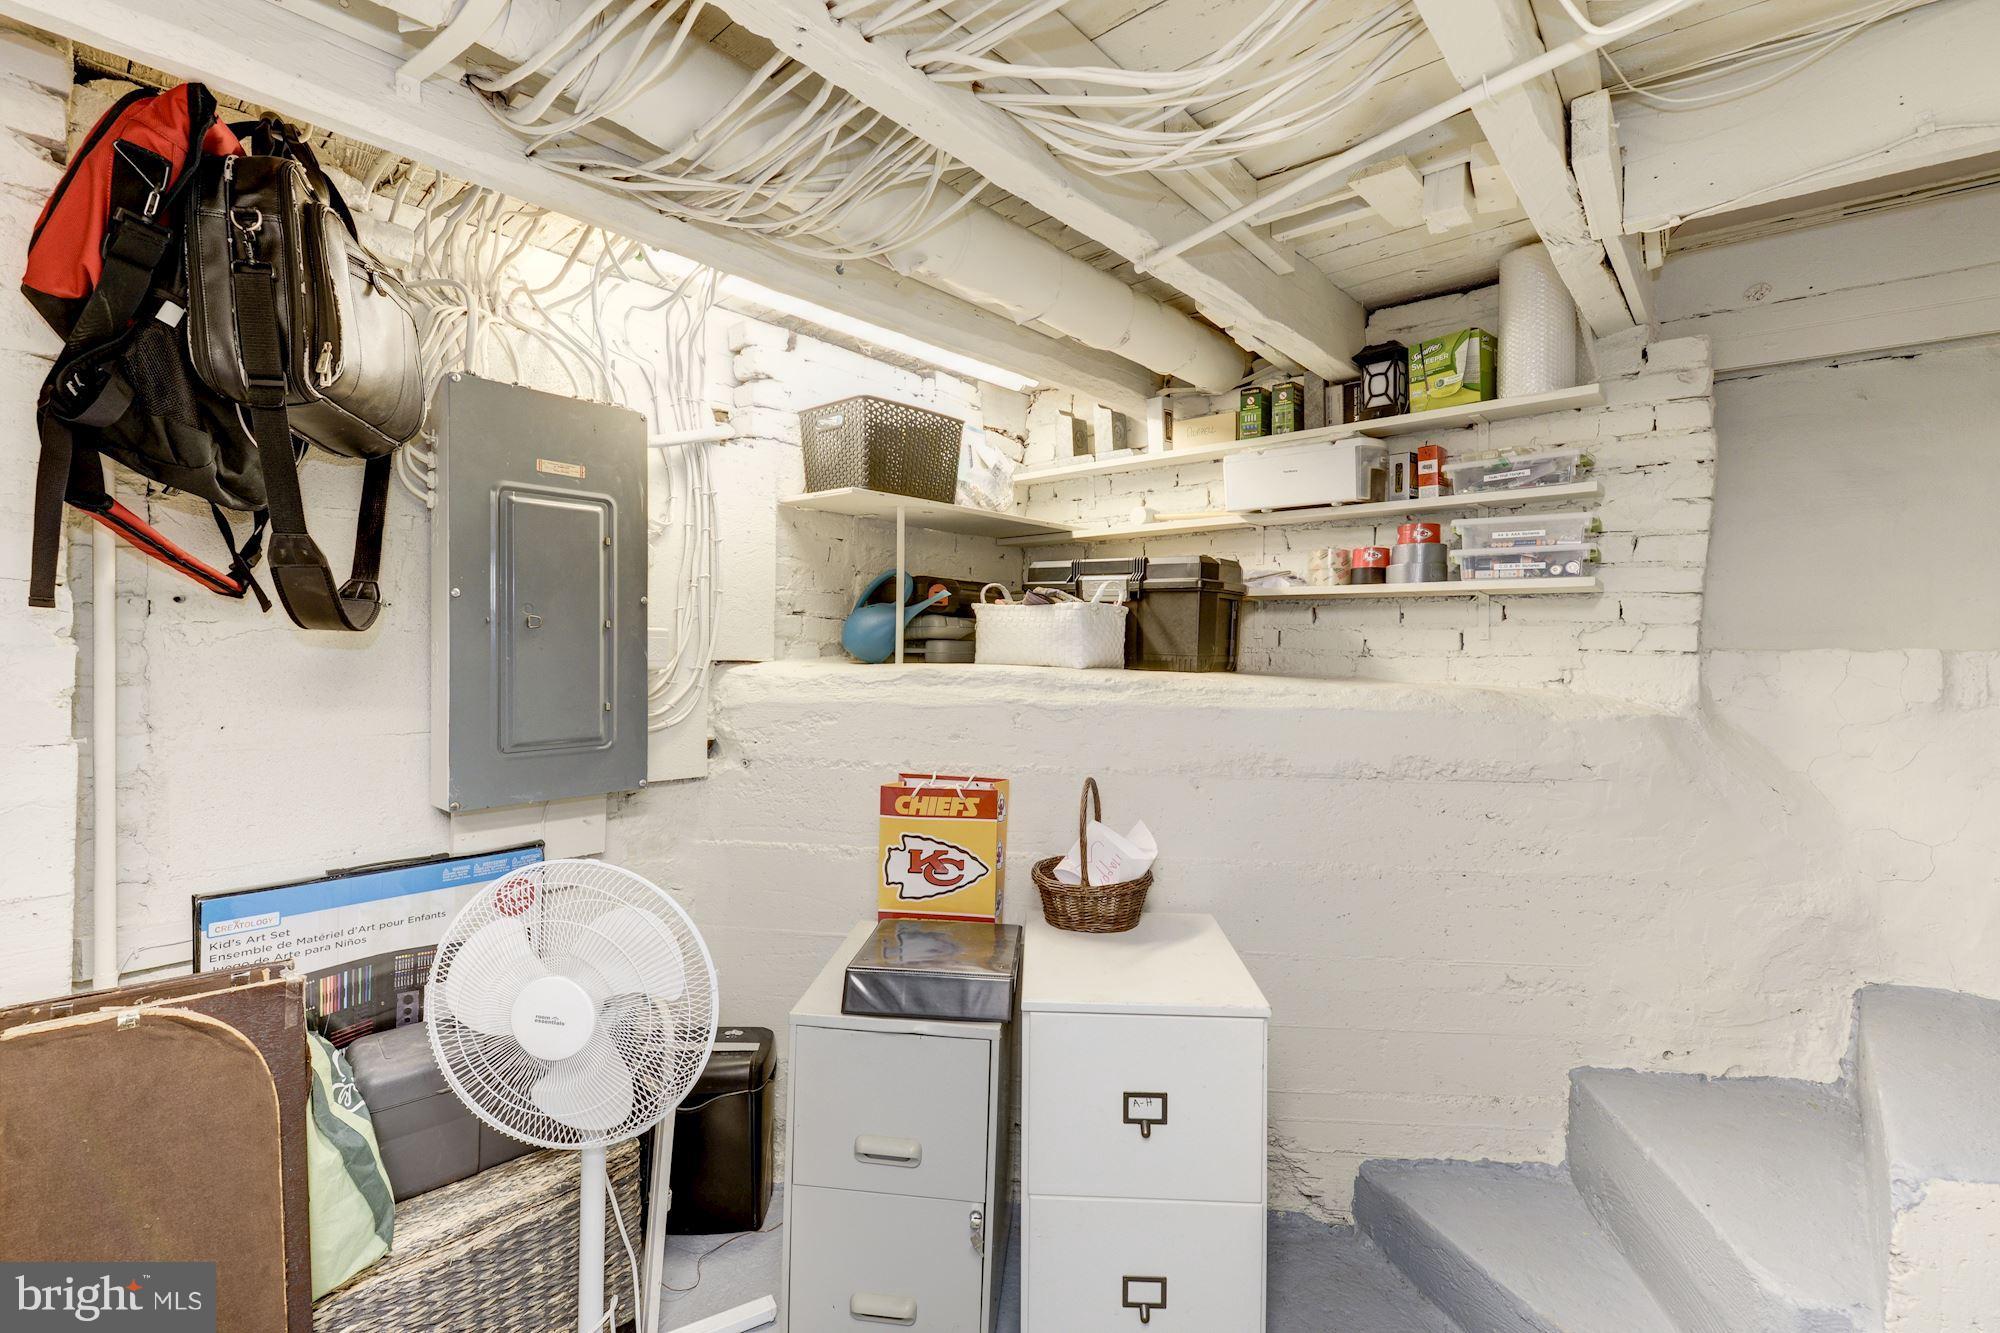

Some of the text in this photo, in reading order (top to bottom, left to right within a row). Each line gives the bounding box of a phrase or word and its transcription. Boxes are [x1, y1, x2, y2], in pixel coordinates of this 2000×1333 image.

[895, 795, 981, 817] CHIEFS
[907, 848, 965, 887] KC
[209, 911, 447, 963] Ensemble de Matériel d'Art pour Enfants
[209, 929, 291, 951] Kid's Art Set
[274, 950, 301, 961] Arte
[305, 944, 331, 957] para
[335, 936, 367, 949] Niños
